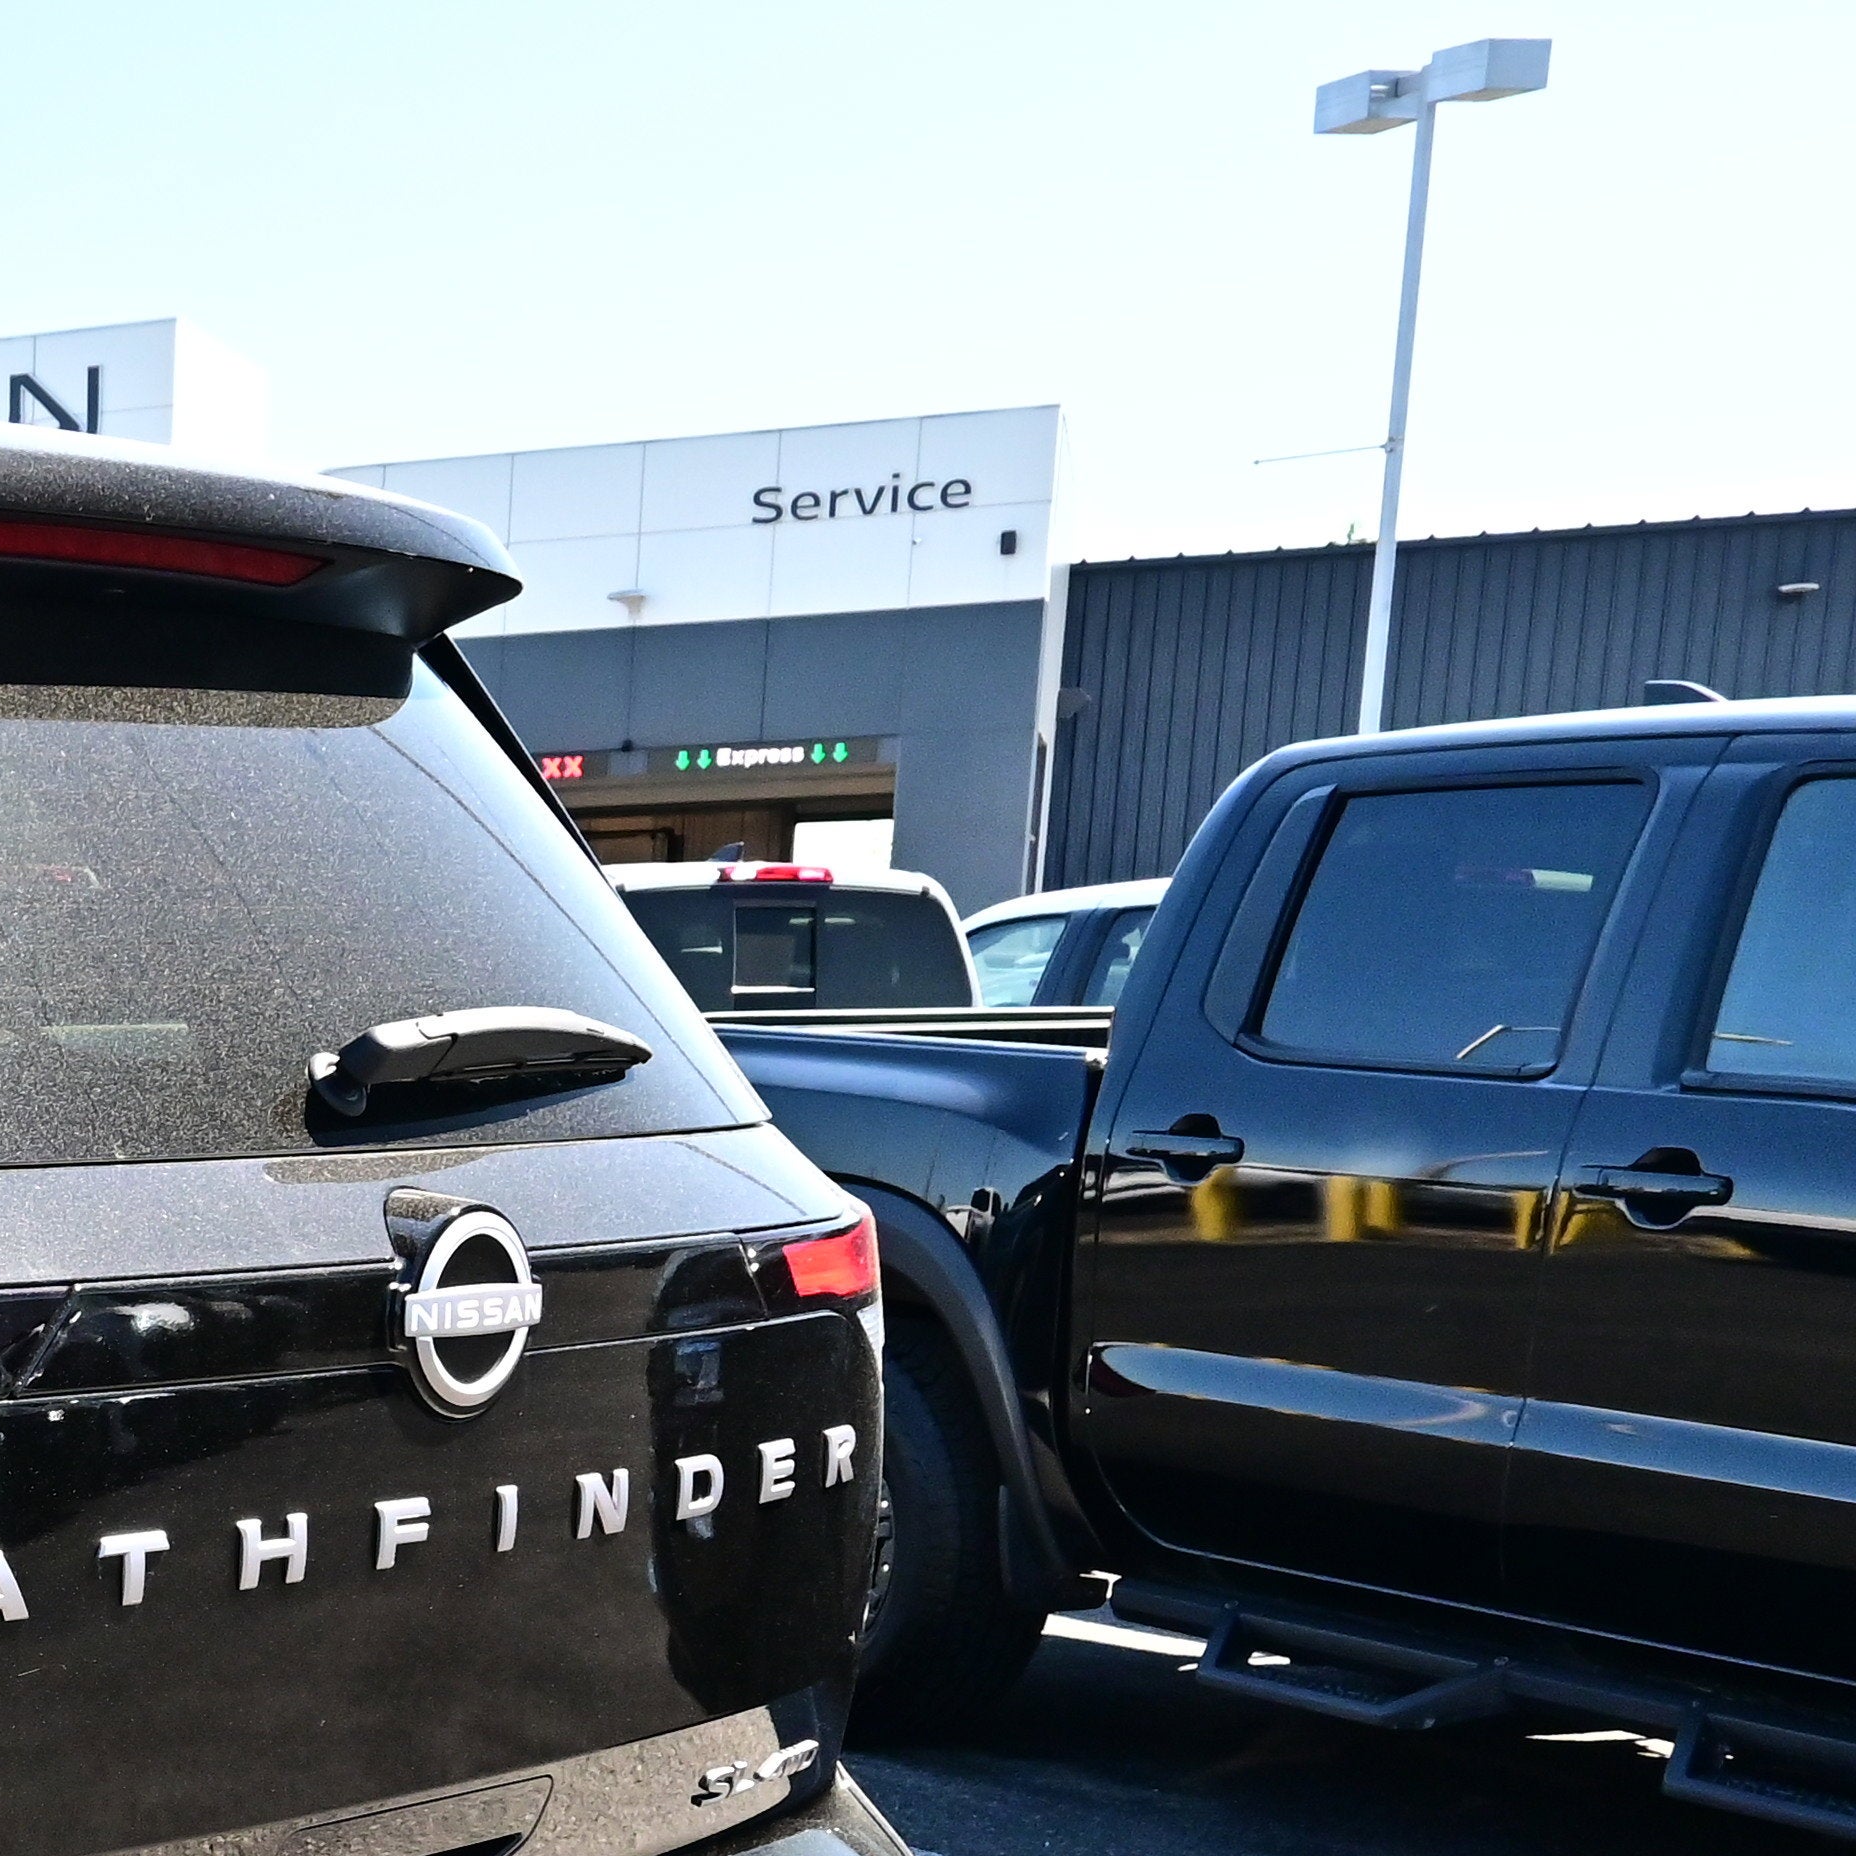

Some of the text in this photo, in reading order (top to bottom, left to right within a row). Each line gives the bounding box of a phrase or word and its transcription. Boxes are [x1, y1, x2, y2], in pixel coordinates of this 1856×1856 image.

[752, 472, 972, 524] Service
[716, 747, 805, 768] Express
[410, 1292, 542, 1332] NISSAN
